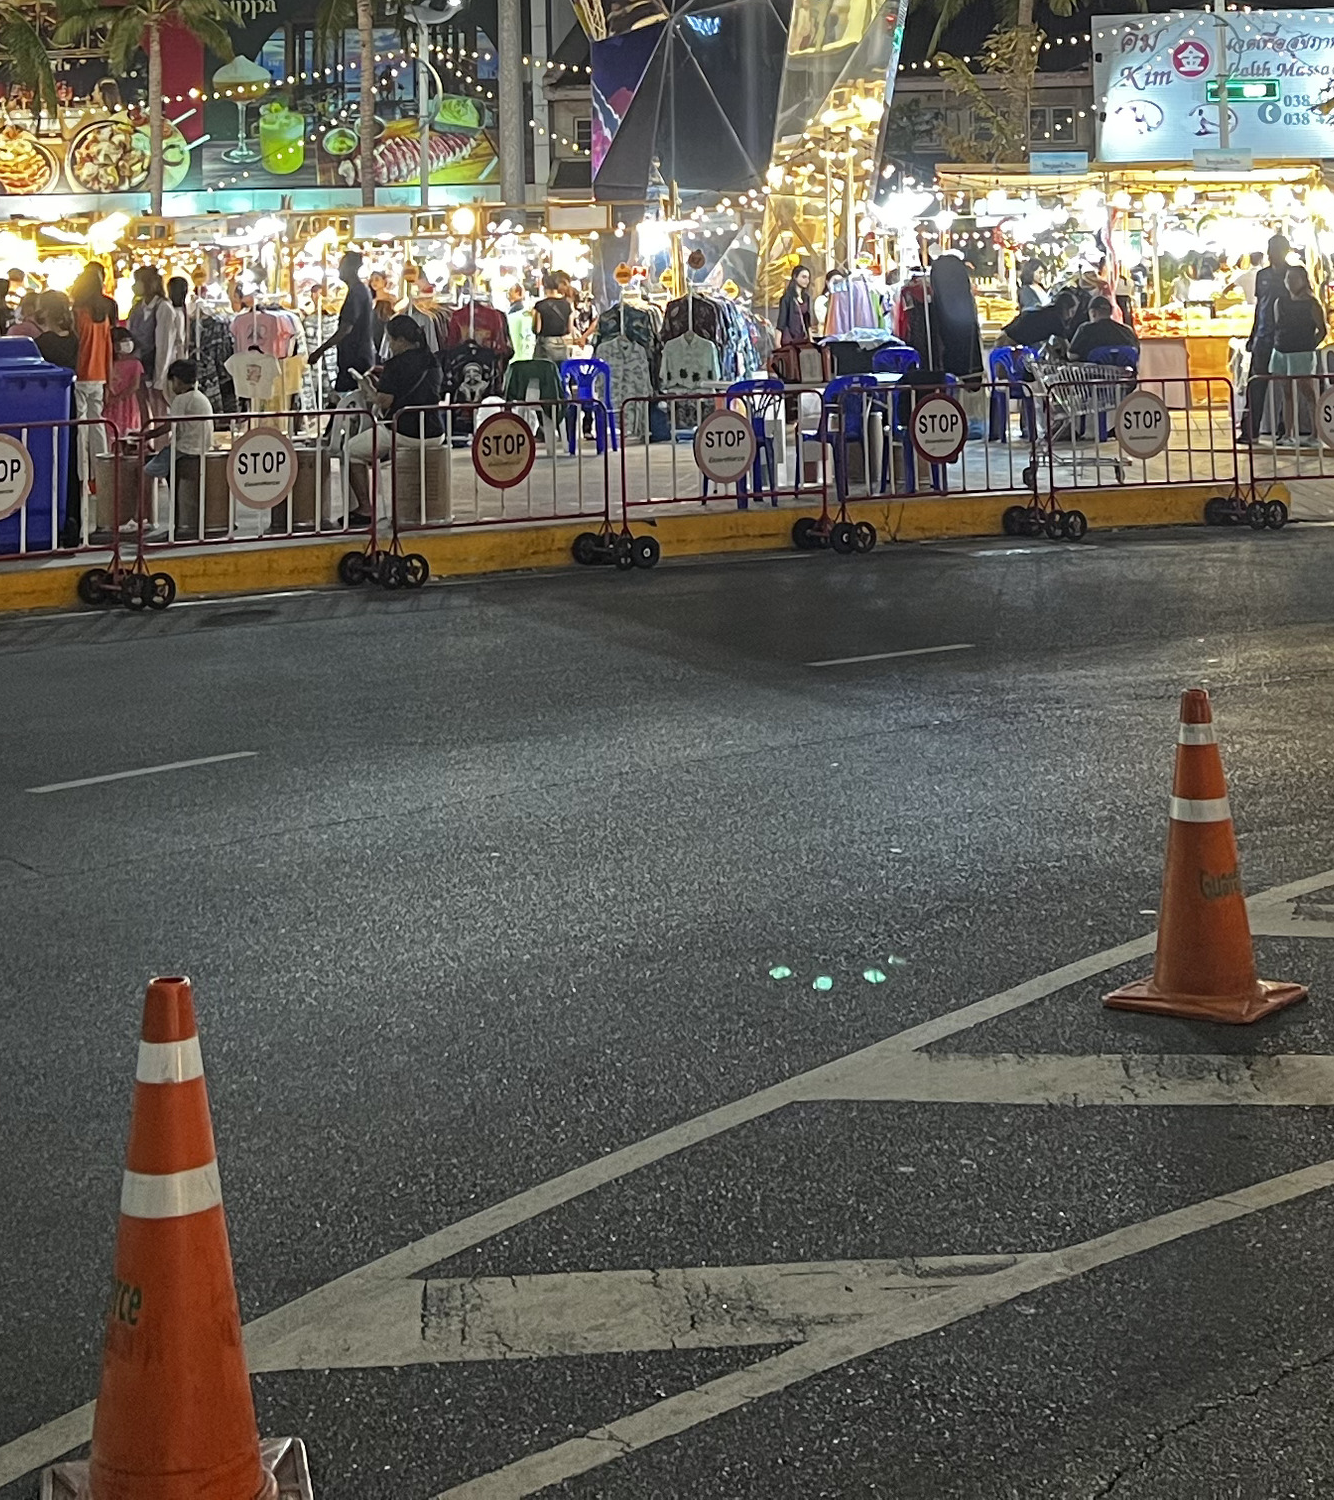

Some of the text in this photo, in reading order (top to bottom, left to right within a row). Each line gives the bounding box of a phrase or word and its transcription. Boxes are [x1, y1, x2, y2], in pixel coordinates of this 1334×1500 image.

[1120, 65, 1174, 91] Kim
[1283, 95, 1311, 108] 038
[1283, 112, 1311, 125] 038
[919, 414, 958, 434] STOP
[1124, 411, 1162, 430] STOP
[482, 434, 525, 457] STOP
[705, 430, 745, 448] STOP
[238, 452, 286, 475] STOP
